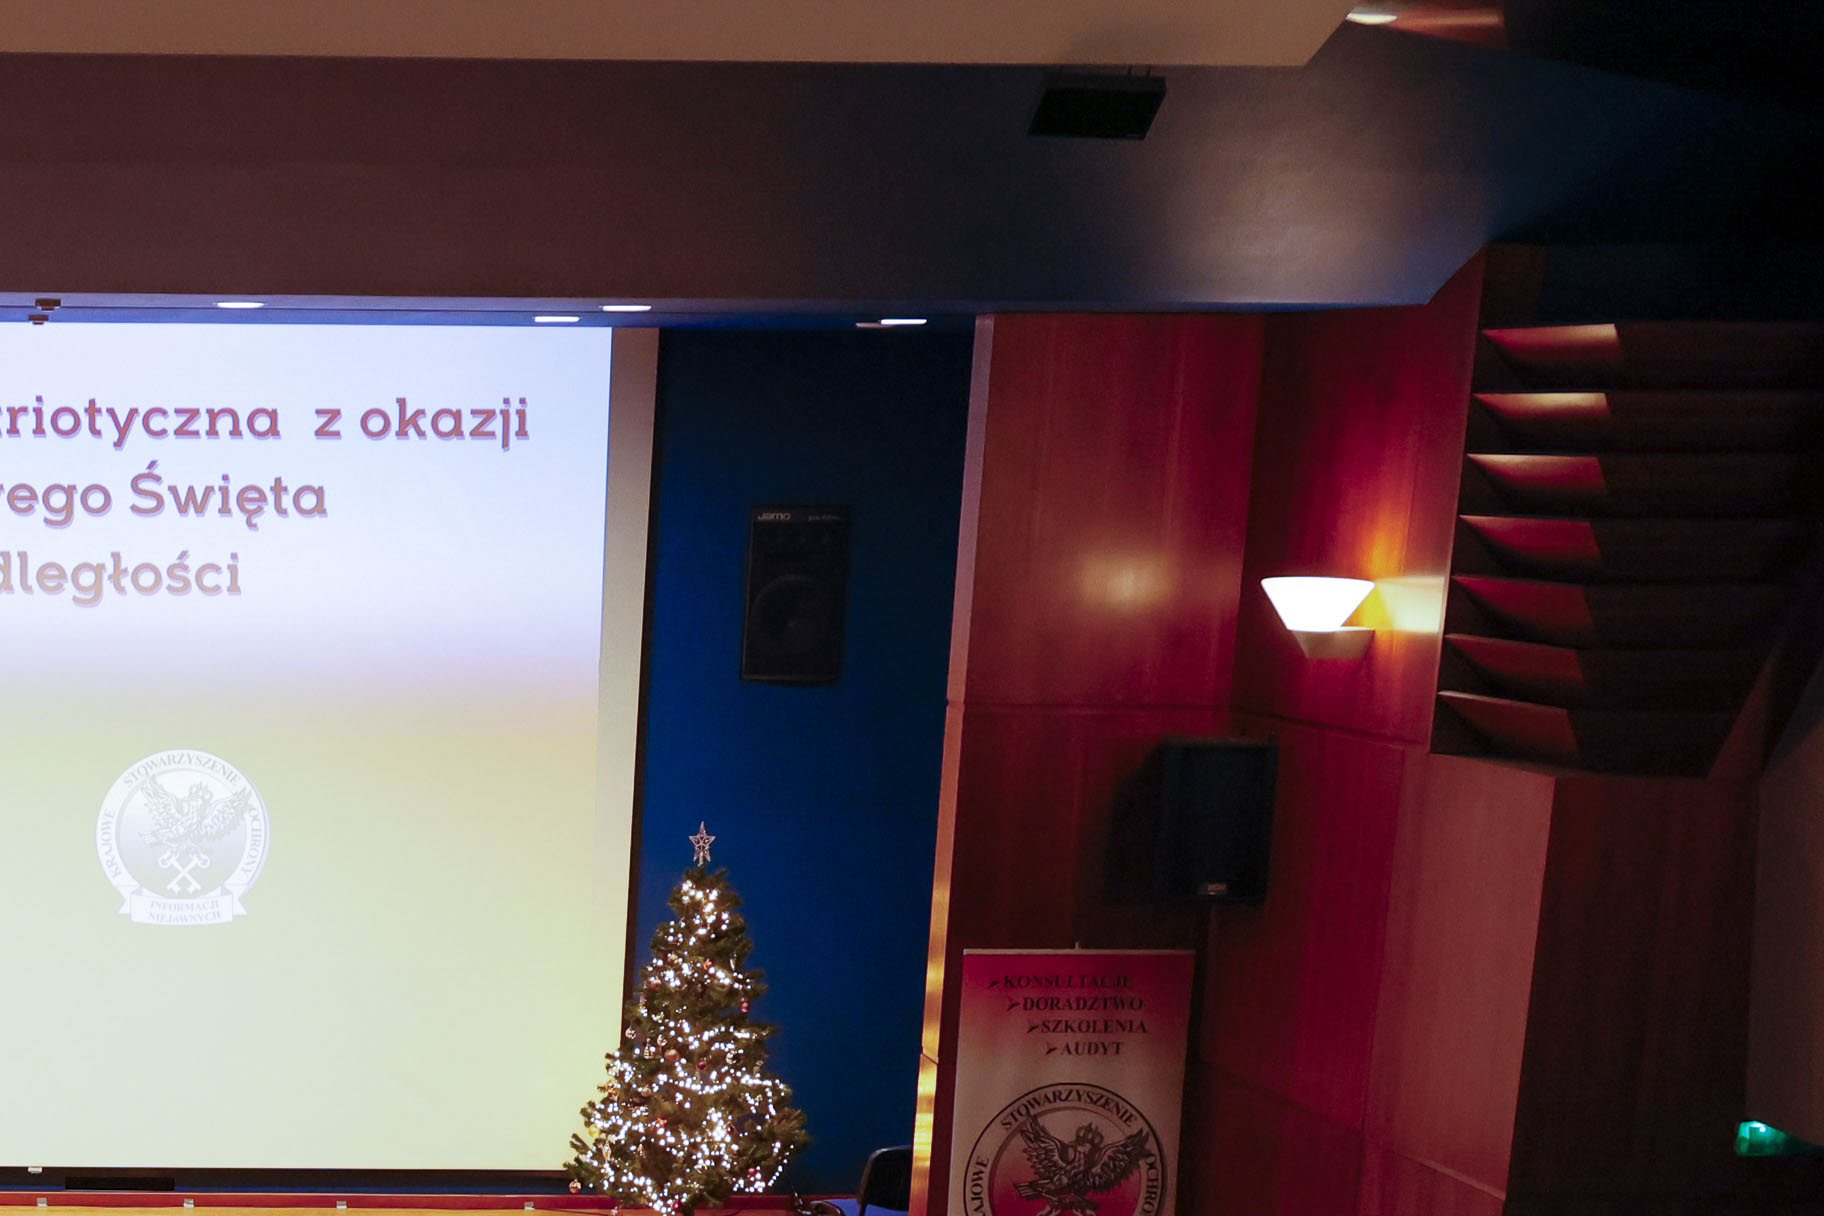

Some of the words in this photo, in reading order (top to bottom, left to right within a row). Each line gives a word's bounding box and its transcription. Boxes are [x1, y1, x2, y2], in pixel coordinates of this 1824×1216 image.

[314, 408, 342, 439] z
[360, 396, 529, 450] okazji
[129, 460, 327, 530] Święta
[123, 752, 242, 788] STOWARZYSZENIE
[101, 807, 123, 879] KRAJOWE
[239, 806, 263, 875] OCHRONY
[1004, 974, 1133, 988] KONSULTACJE
[1022, 996, 1144, 1011] DORADZTWO
[1041, 1019, 1148, 1034] SZKOLENIA
[1060, 1041, 1123, 1056] AUDYT
[1001, 1088, 1138, 1129] STOWARZYSZENIE
